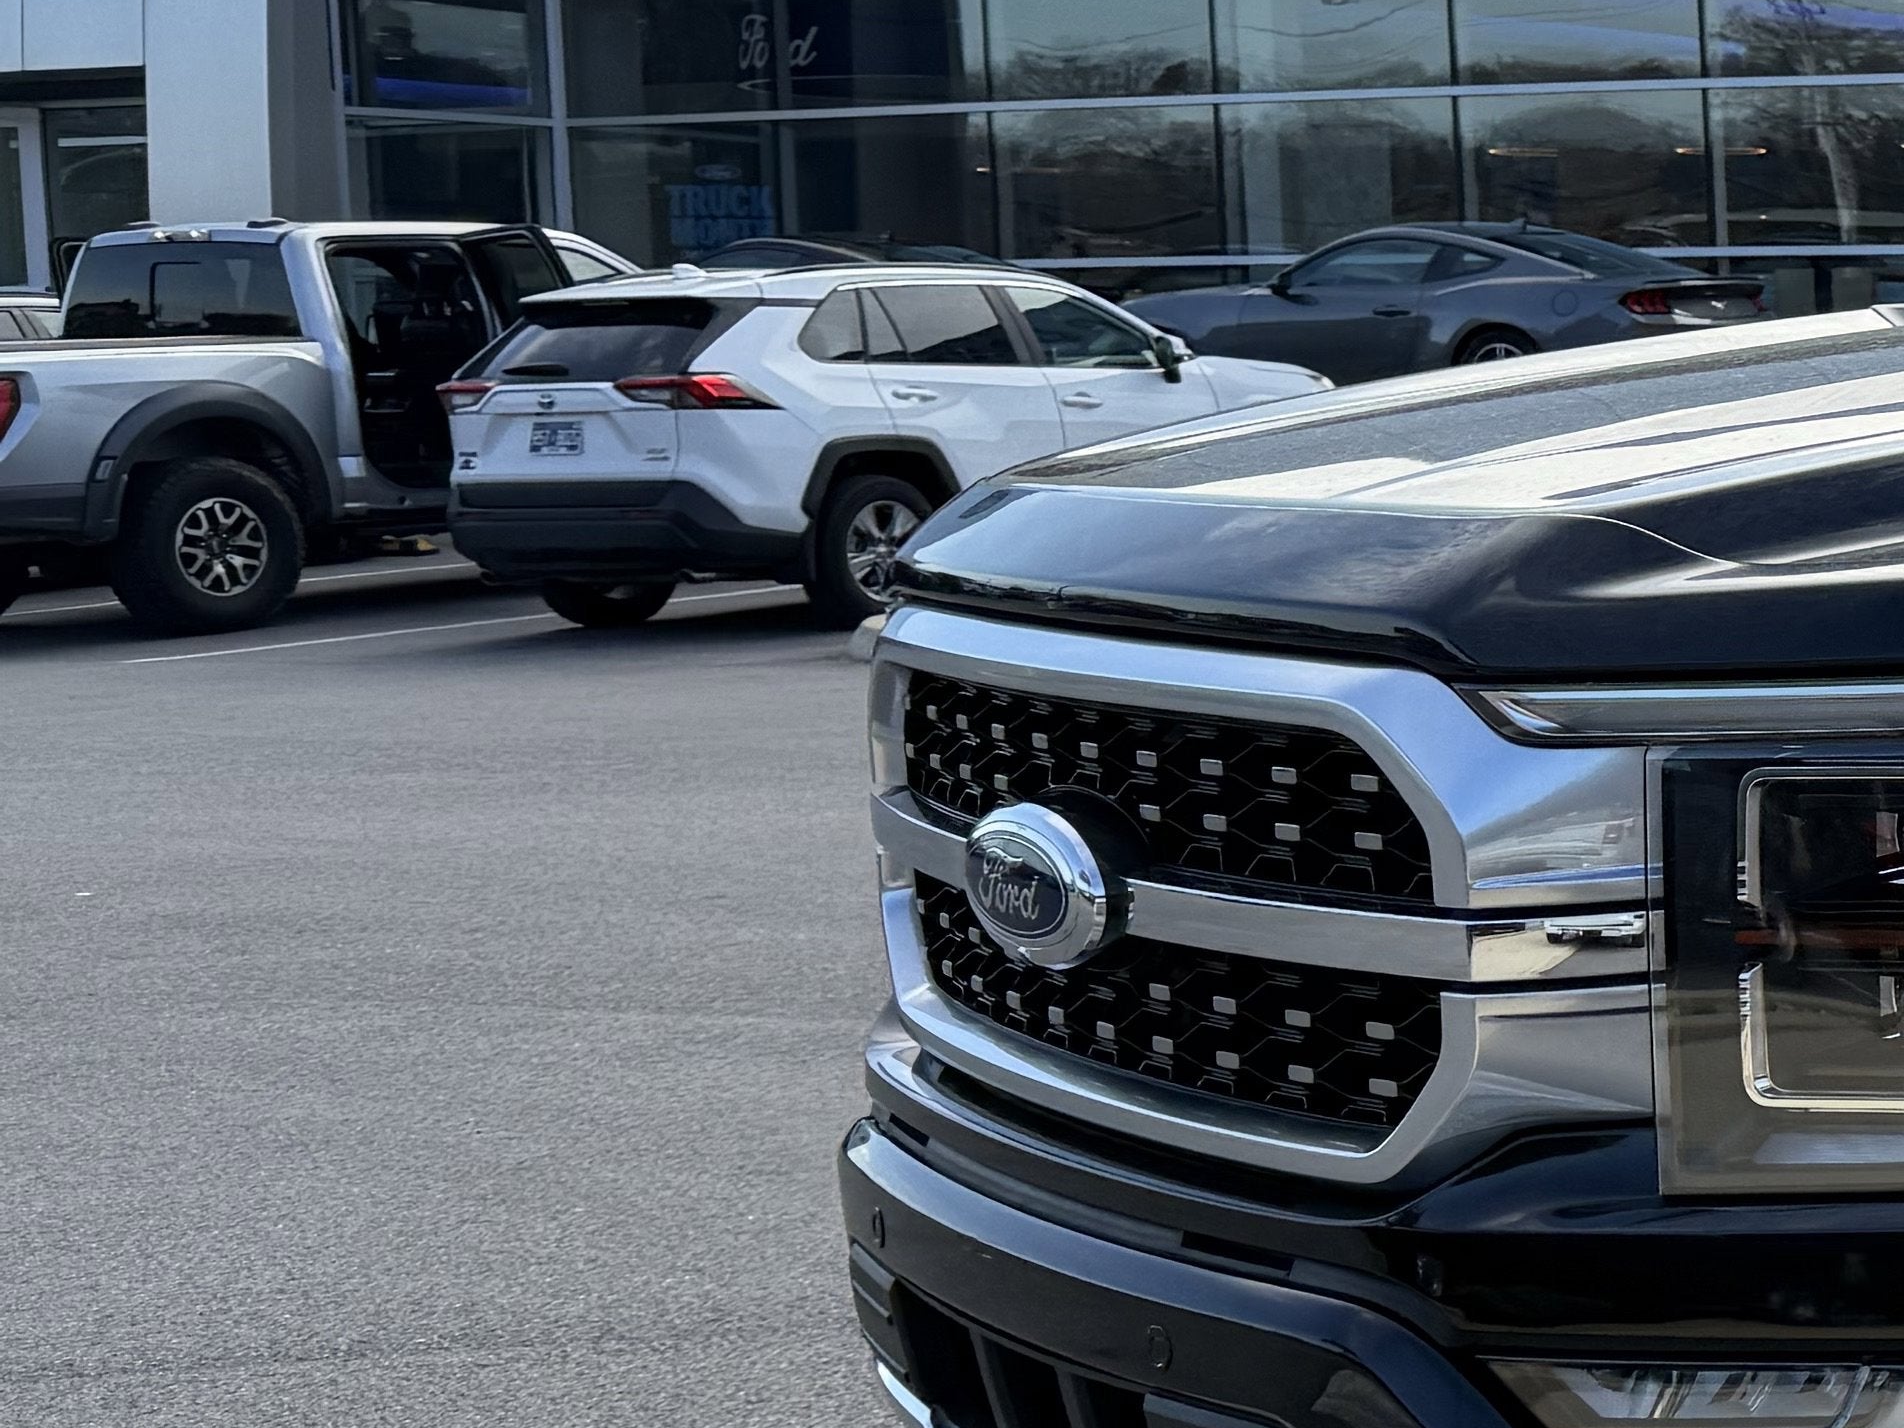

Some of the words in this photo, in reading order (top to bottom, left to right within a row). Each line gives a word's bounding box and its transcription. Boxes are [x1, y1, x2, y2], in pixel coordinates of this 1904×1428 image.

[738, 13, 819, 71] Fod
[665, 184, 774, 216] TRUCK
[977, 846, 1040, 921] Ford
